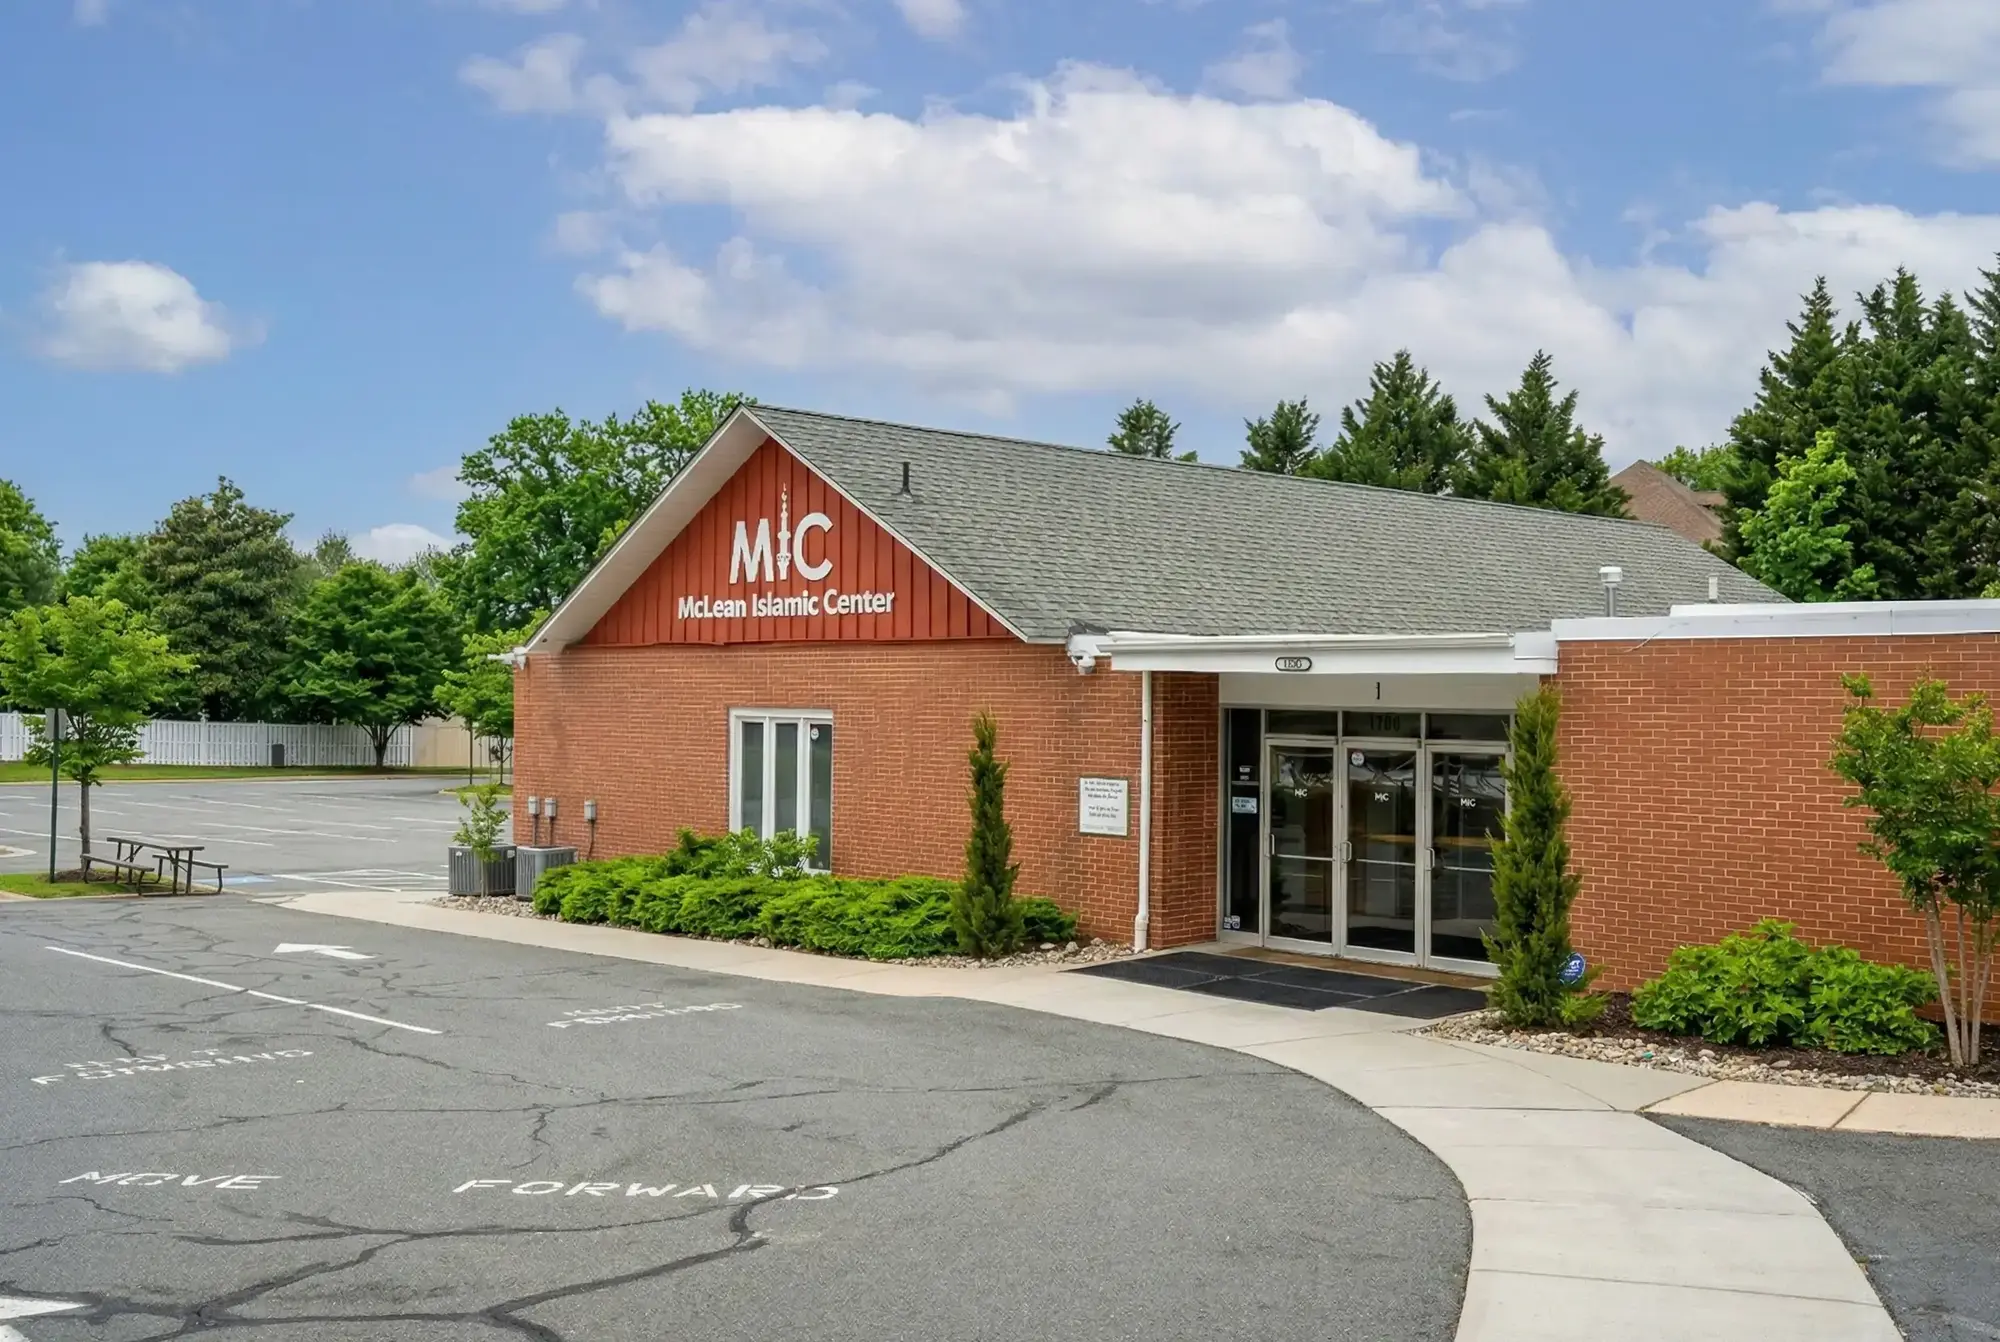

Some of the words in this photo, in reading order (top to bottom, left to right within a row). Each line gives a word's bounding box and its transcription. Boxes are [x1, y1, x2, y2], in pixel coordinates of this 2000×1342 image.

[729, 483, 834, 584] MIC
[678, 595, 747, 619] McLean
[752, 590, 819, 617] Islamic
[823, 588, 895, 615] Center
[57, 1171, 282, 1190] MOVE
[451, 1179, 840, 1201] FORWARD
